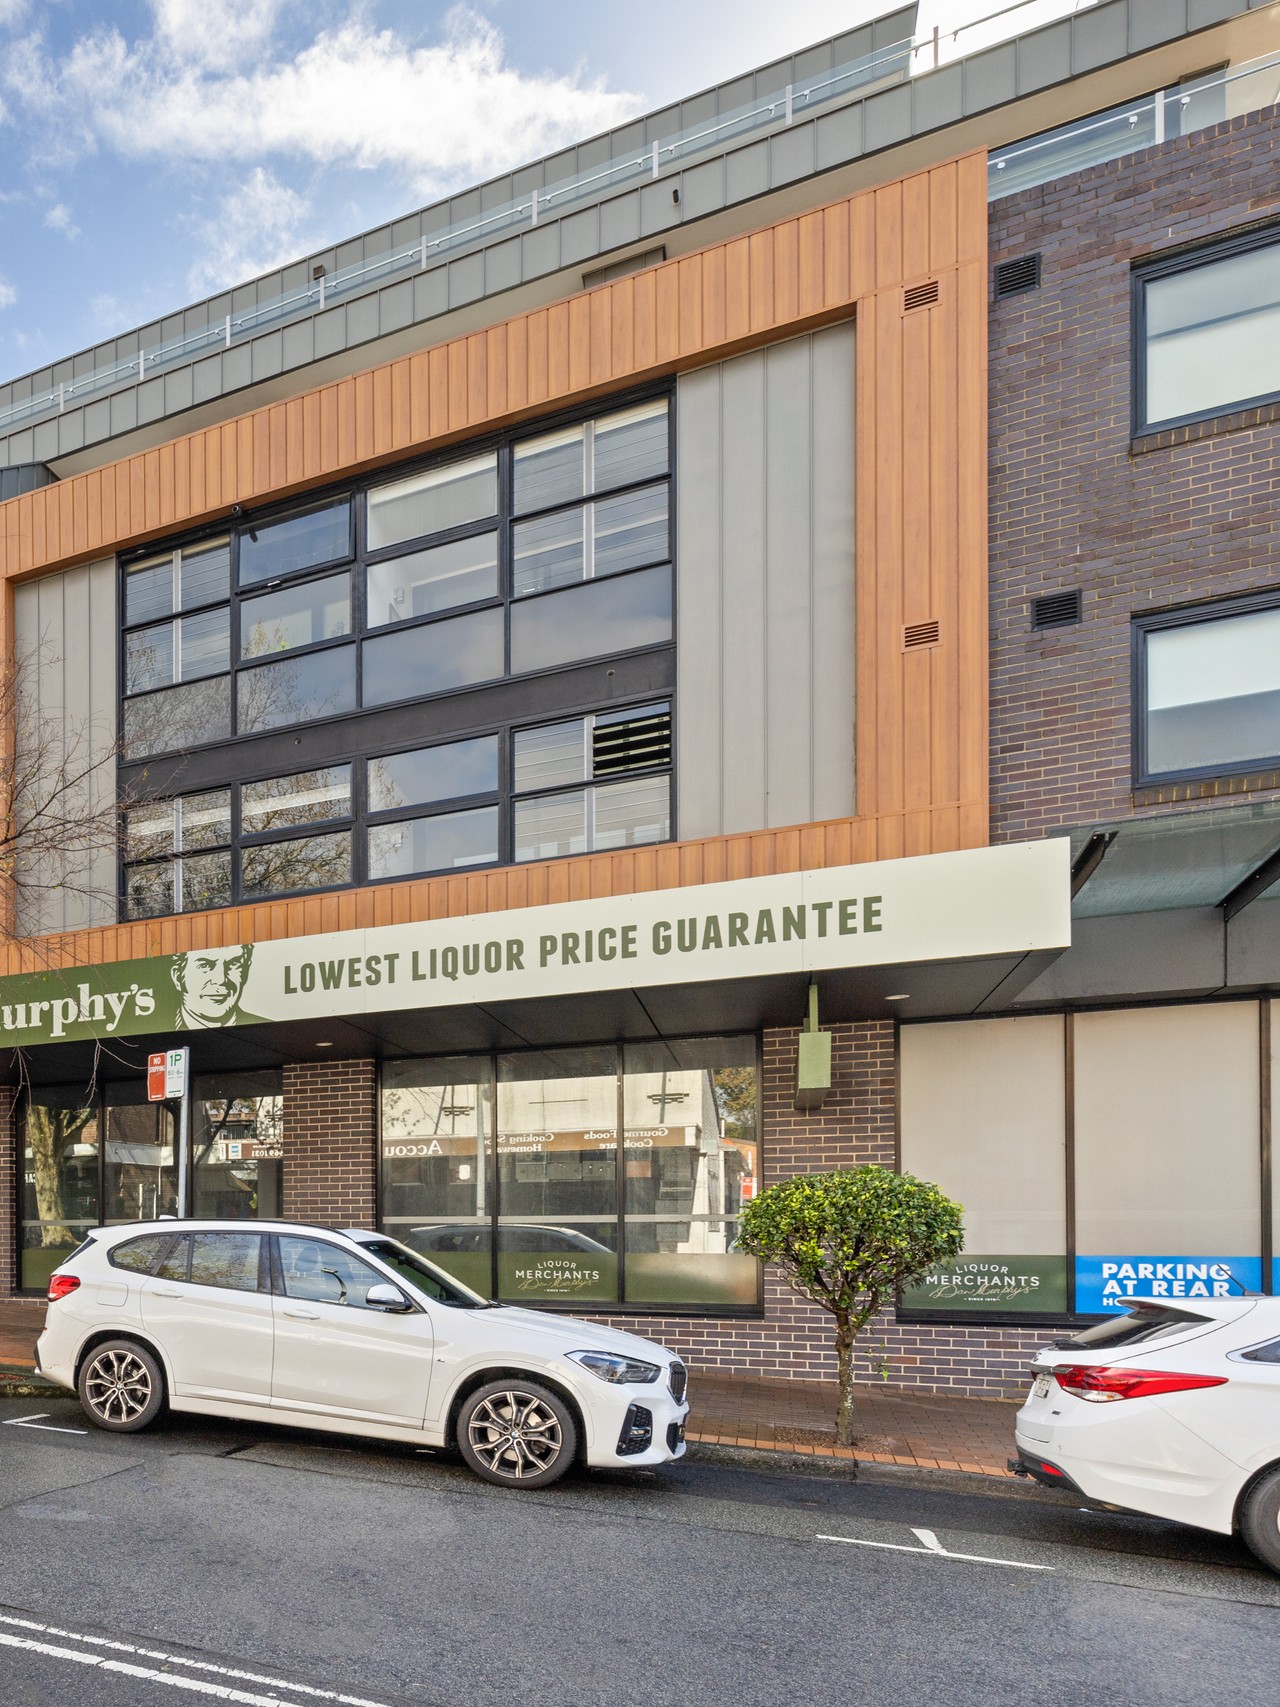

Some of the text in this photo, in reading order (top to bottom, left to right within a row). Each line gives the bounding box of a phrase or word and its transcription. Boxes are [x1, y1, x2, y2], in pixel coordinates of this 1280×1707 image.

[283, 895, 883, 995] LOWEST LIQUOR PRICE GUARANTEE
[153, 1056, 162, 1065] NO
[170, 1053, 182, 1067] 1P
[537, 1260, 577, 1270] LIQUOR
[955, 1263, 1009, 1274] LIQUOR
[1102, 1263, 1232, 1280] PARKING
[515, 1270, 600, 1280] MERCHANTS
[925, 1275, 1040, 1287] MERCHANTS
[928, 1283, 1039, 1300] Dan Murphy's
[1102, 1279, 1232, 1297] AT REAR
